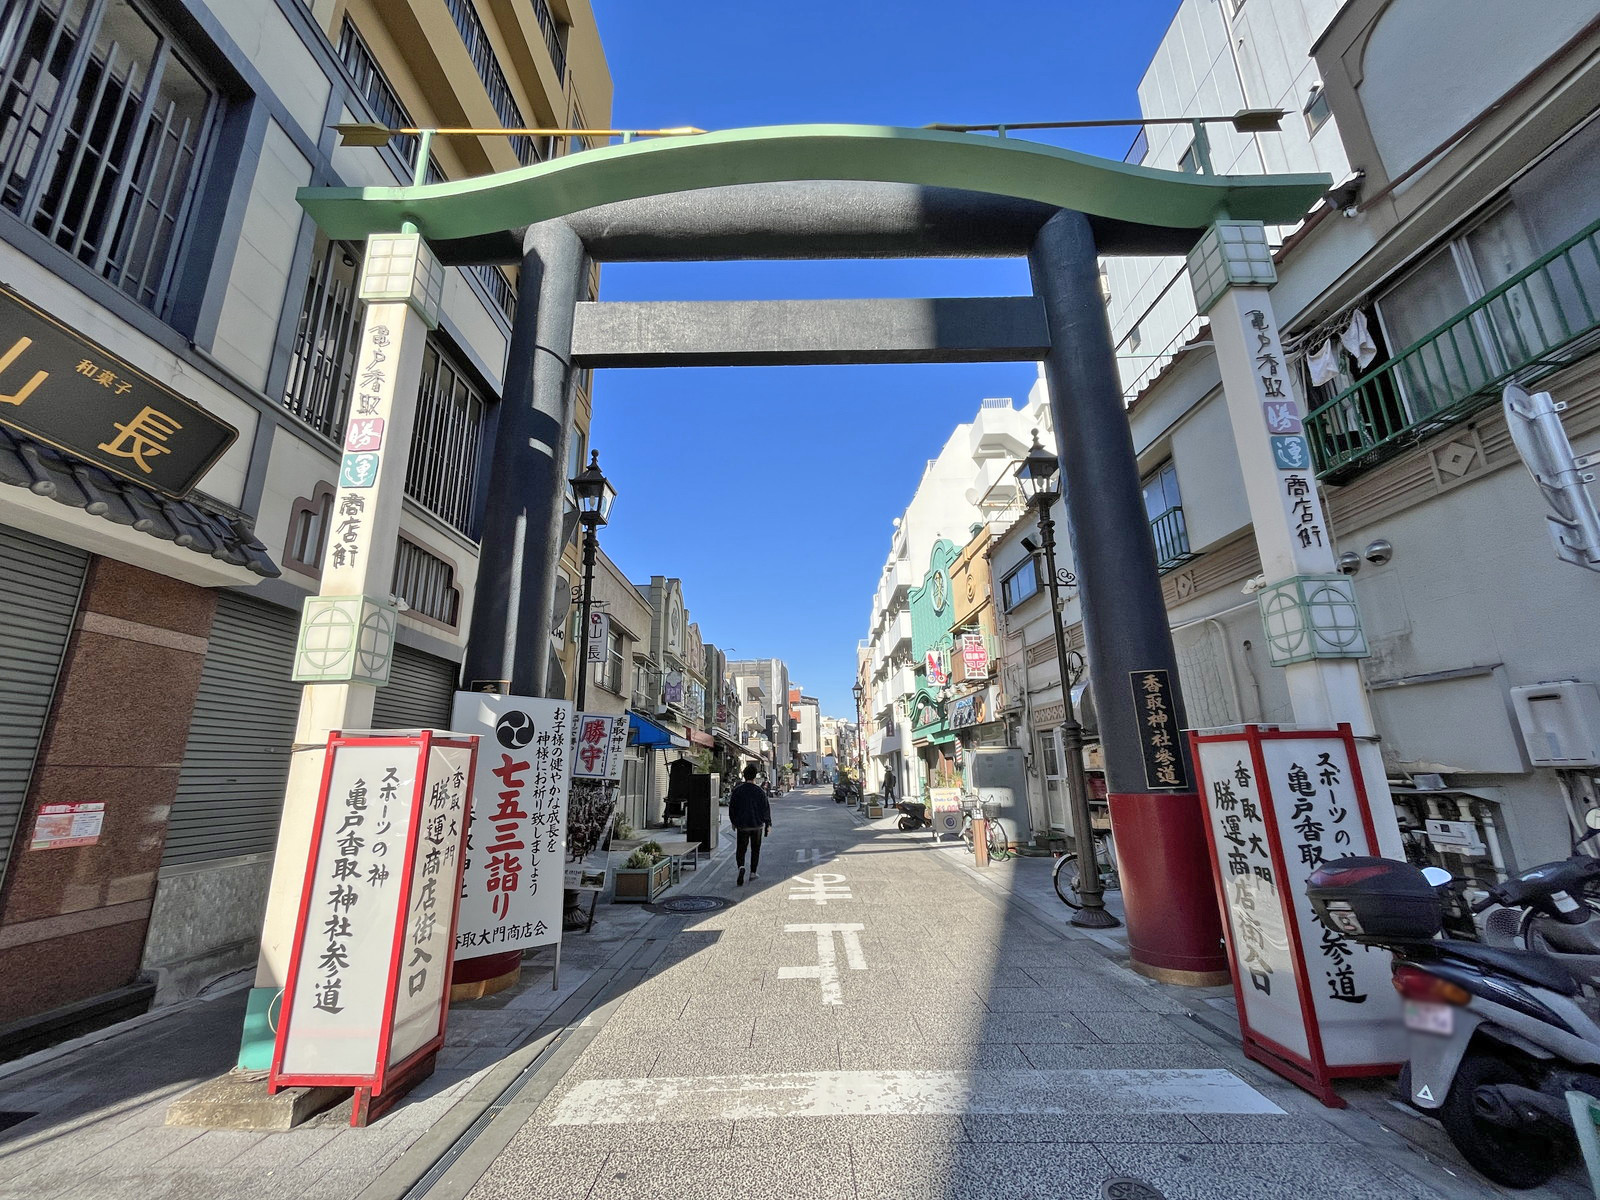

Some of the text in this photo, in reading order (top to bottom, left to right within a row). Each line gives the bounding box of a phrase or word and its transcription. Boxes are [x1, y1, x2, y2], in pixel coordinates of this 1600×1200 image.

[75, 358, 133, 395] 和菓子
[98, 406, 183, 474] 長
[588, 624, 602, 660] 山長
[546, 707, 566, 853] お子様の健やかな成長を
[580, 718, 608, 774] 勝守
[610, 717, 628, 753] 香取神社
[366, 767, 400, 889] スポーツの神
[442, 765, 465, 867] 香取大門
[484, 753, 531, 922] 七五三詣り
[530, 731, 551, 897] 神様にお祈り致しましょう
[1234, 760, 1276, 896] 香取大門
[1316, 752, 1357, 858] スポーツの
[312, 777, 369, 1015] 亀戸香取神社参道
[408, 776, 450, 998] 勝運商店街入口
[1213, 778, 1274, 997] 勝運商店街入口
[1287, 762, 1368, 1004] 亀戸香取参道
